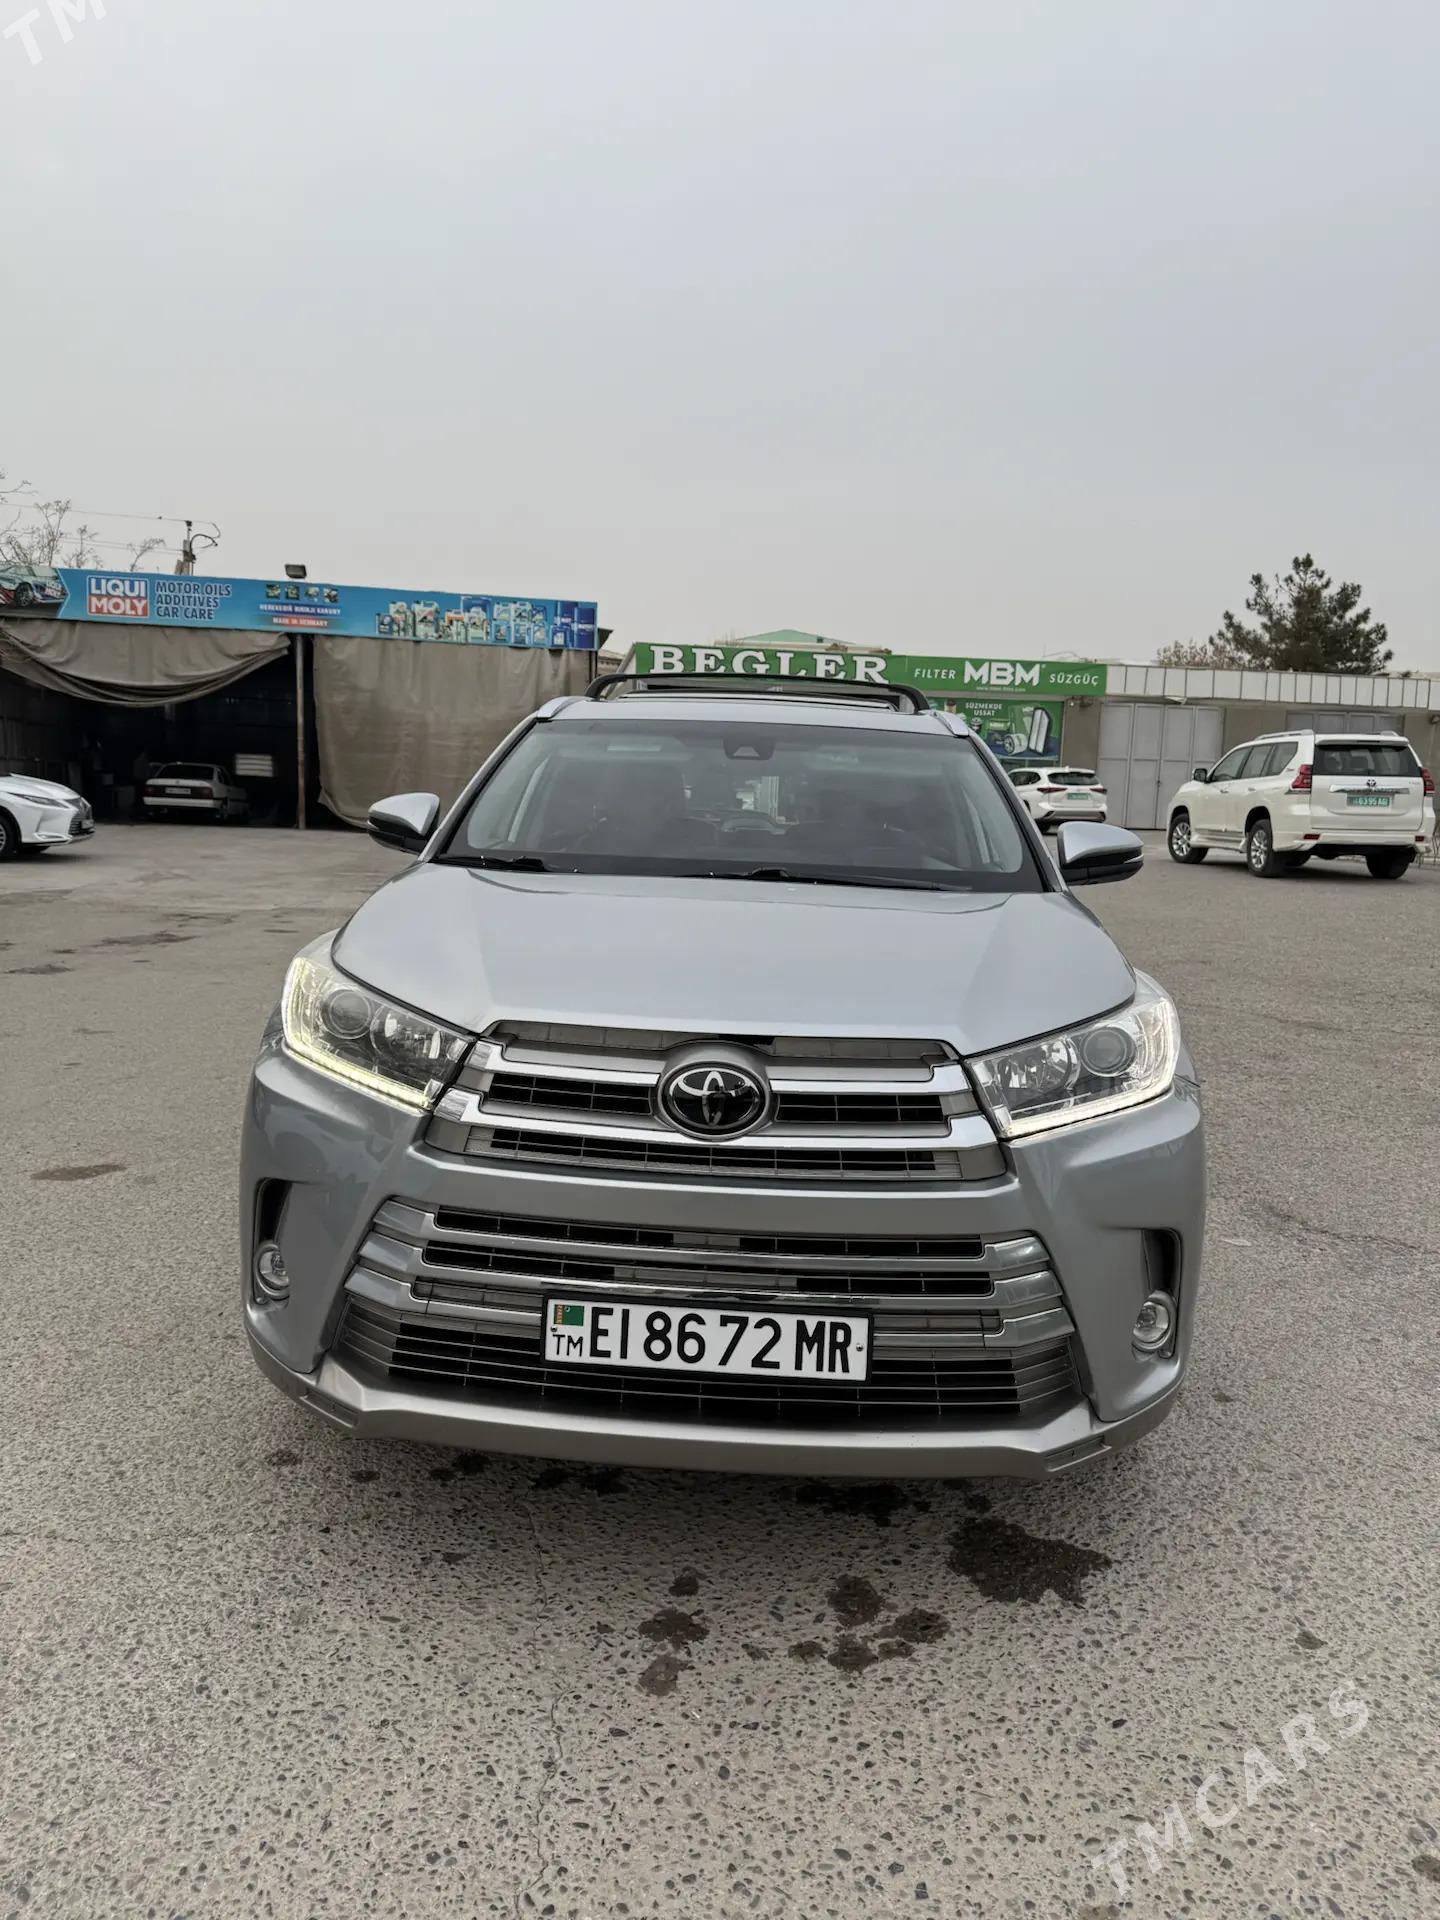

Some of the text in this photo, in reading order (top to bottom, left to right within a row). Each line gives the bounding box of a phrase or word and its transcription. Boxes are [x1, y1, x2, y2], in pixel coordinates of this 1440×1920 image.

[90, 577, 146, 597] LIQUI
[155, 581, 232, 597] MOTOR OILS
[90, 596, 147, 616] MOLY
[155, 594, 220, 609] ADDITIVES
[156, 606, 214, 620] CAR CARE
[649, 645, 889, 684] BEGLER
[914, 667, 957, 680] FILTER
[963, 659, 1041, 687] MBM
[1049, 672, 1100, 687] SÜZGÜÇ
[552, 1333, 584, 1358] TM
